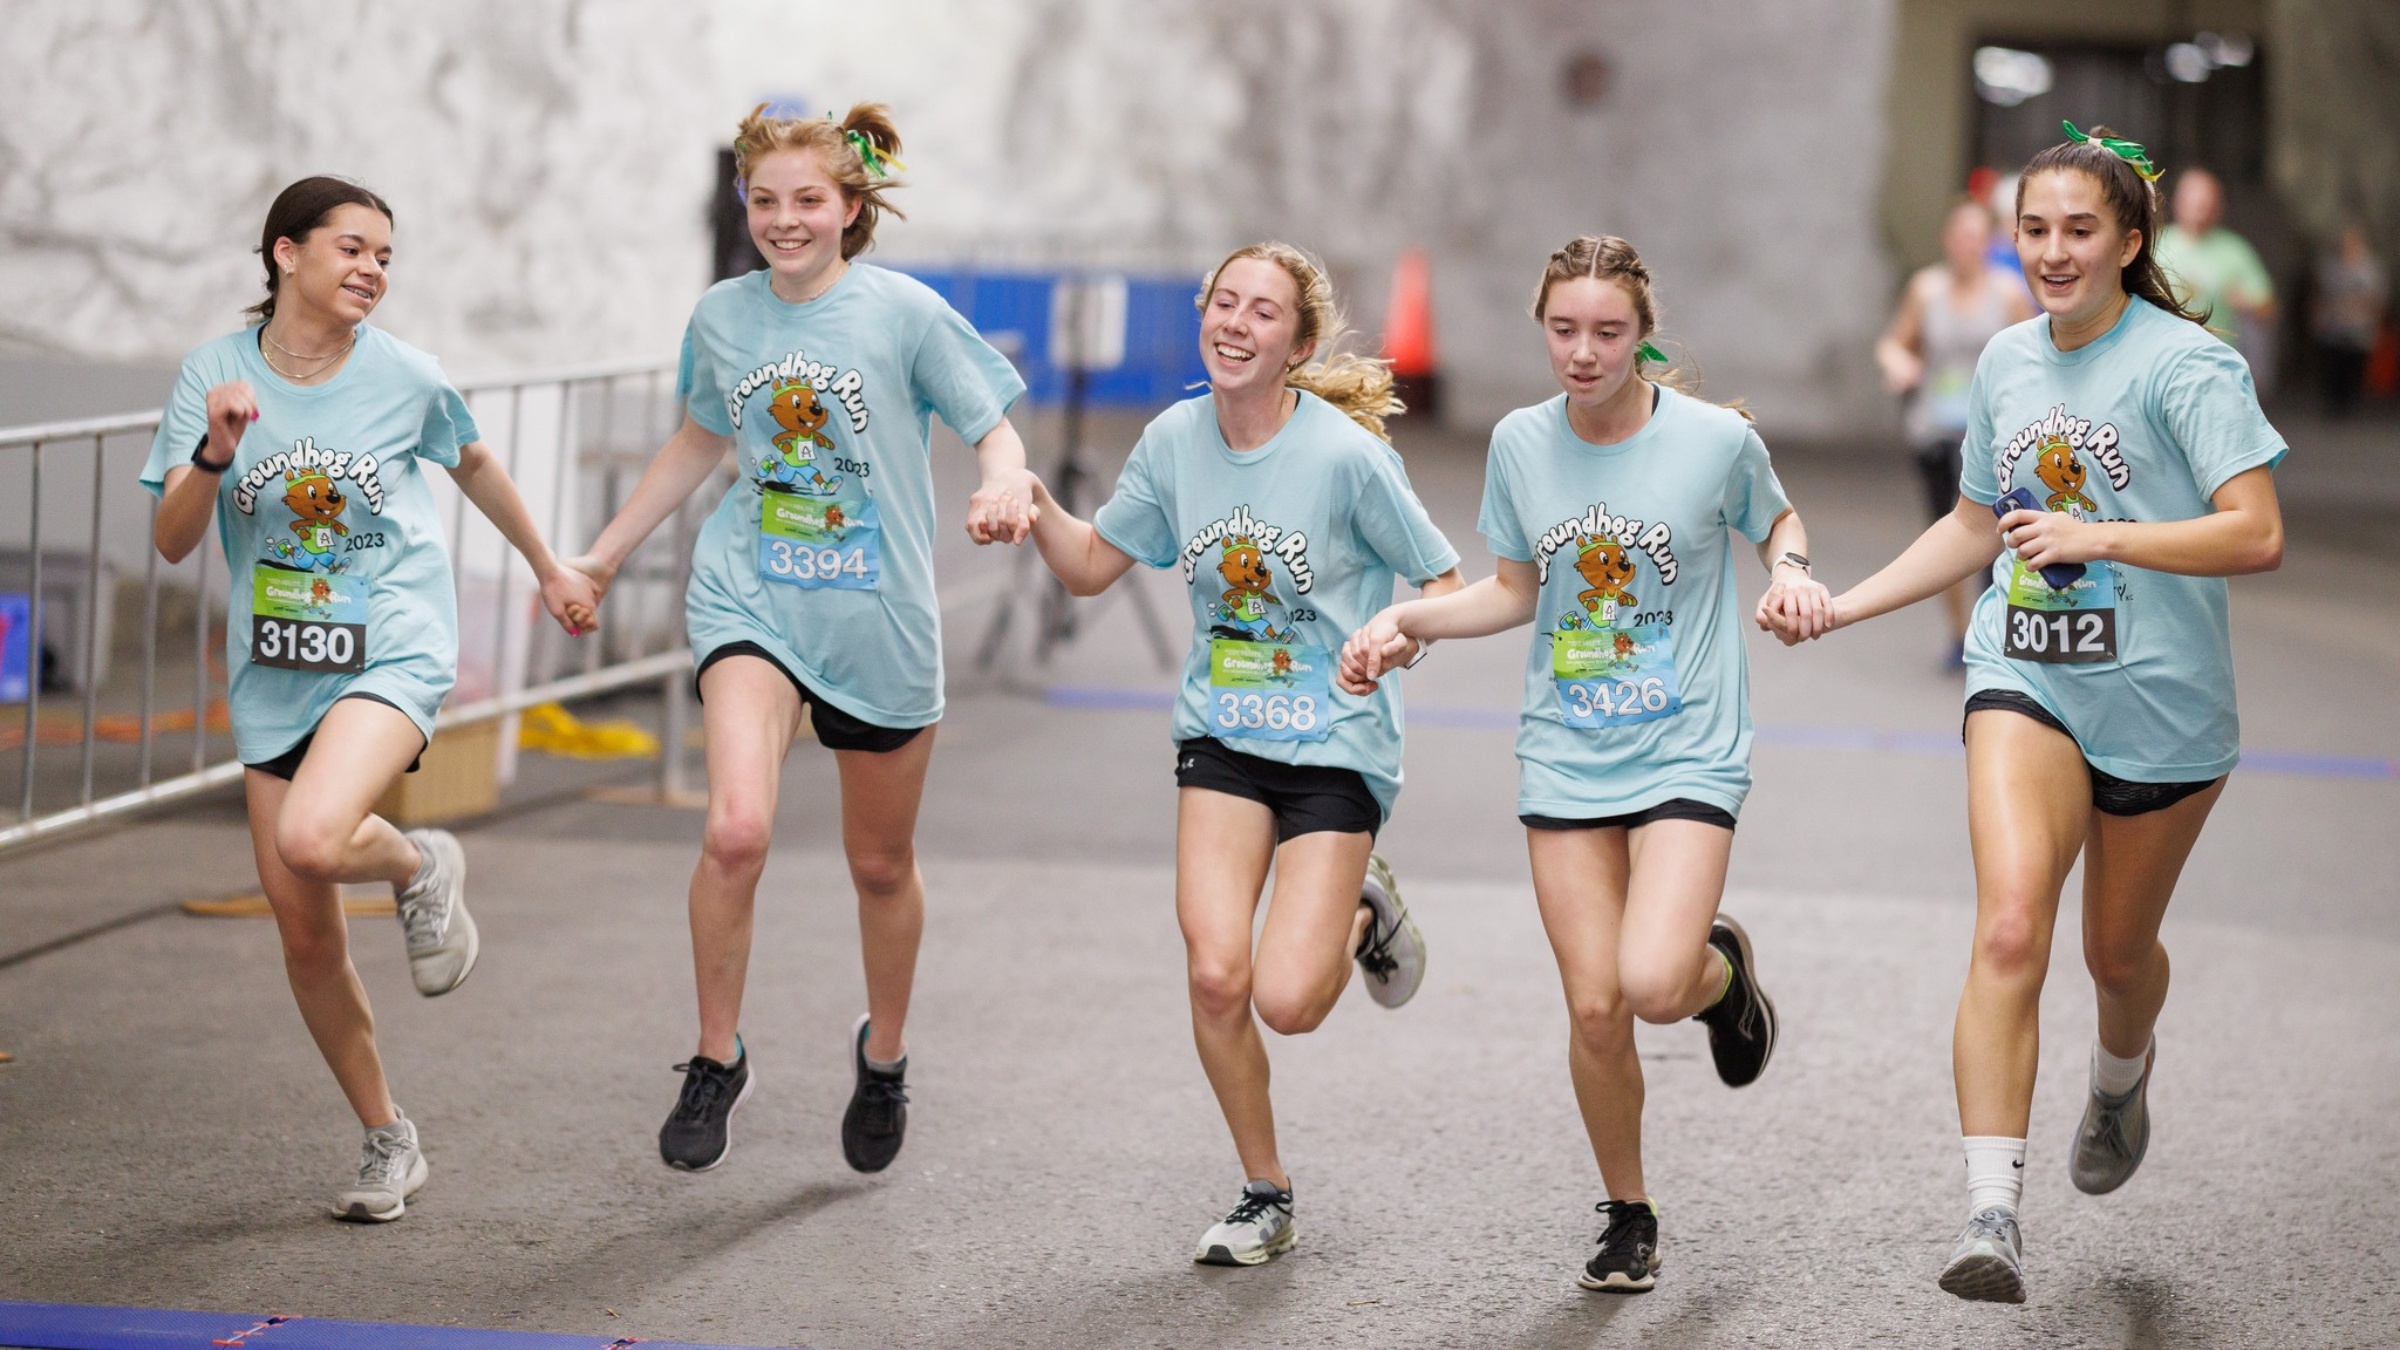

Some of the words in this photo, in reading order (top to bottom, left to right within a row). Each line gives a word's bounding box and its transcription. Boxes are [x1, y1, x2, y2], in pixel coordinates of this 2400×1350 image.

[728, 349, 837, 430] Groundhog
[831, 368, 870, 434] Run
[801, 446, 812, 458] A
[834, 457, 870, 478] 2023
[1998, 403, 2091, 495] Groundhog
[2085, 422, 2130, 492] Run
[232, 436, 352, 515] Groundhog
[348, 452, 384, 515] Run
[776, 507, 826, 529] Groundhog
[319, 533, 330, 544] A
[344, 533, 385, 552] 2023
[1181, 504, 1282, 585] Groundhog
[1275, 531, 1314, 595] Run
[1637, 522, 1678, 586] Run
[770, 541, 868, 580] 3394
[1251, 601, 1262, 612] A
[1284, 609, 1317, 626] 023
[260, 620, 354, 664] 3130
[2012, 611, 2105, 653] 3012
[1223, 657, 1274, 674] Groundhog
[1291, 660, 1313, 673] Run
[1567, 647, 1616, 660] Groundhog
[1218, 692, 1317, 731] 3368
[1569, 676, 1669, 718] 3426
